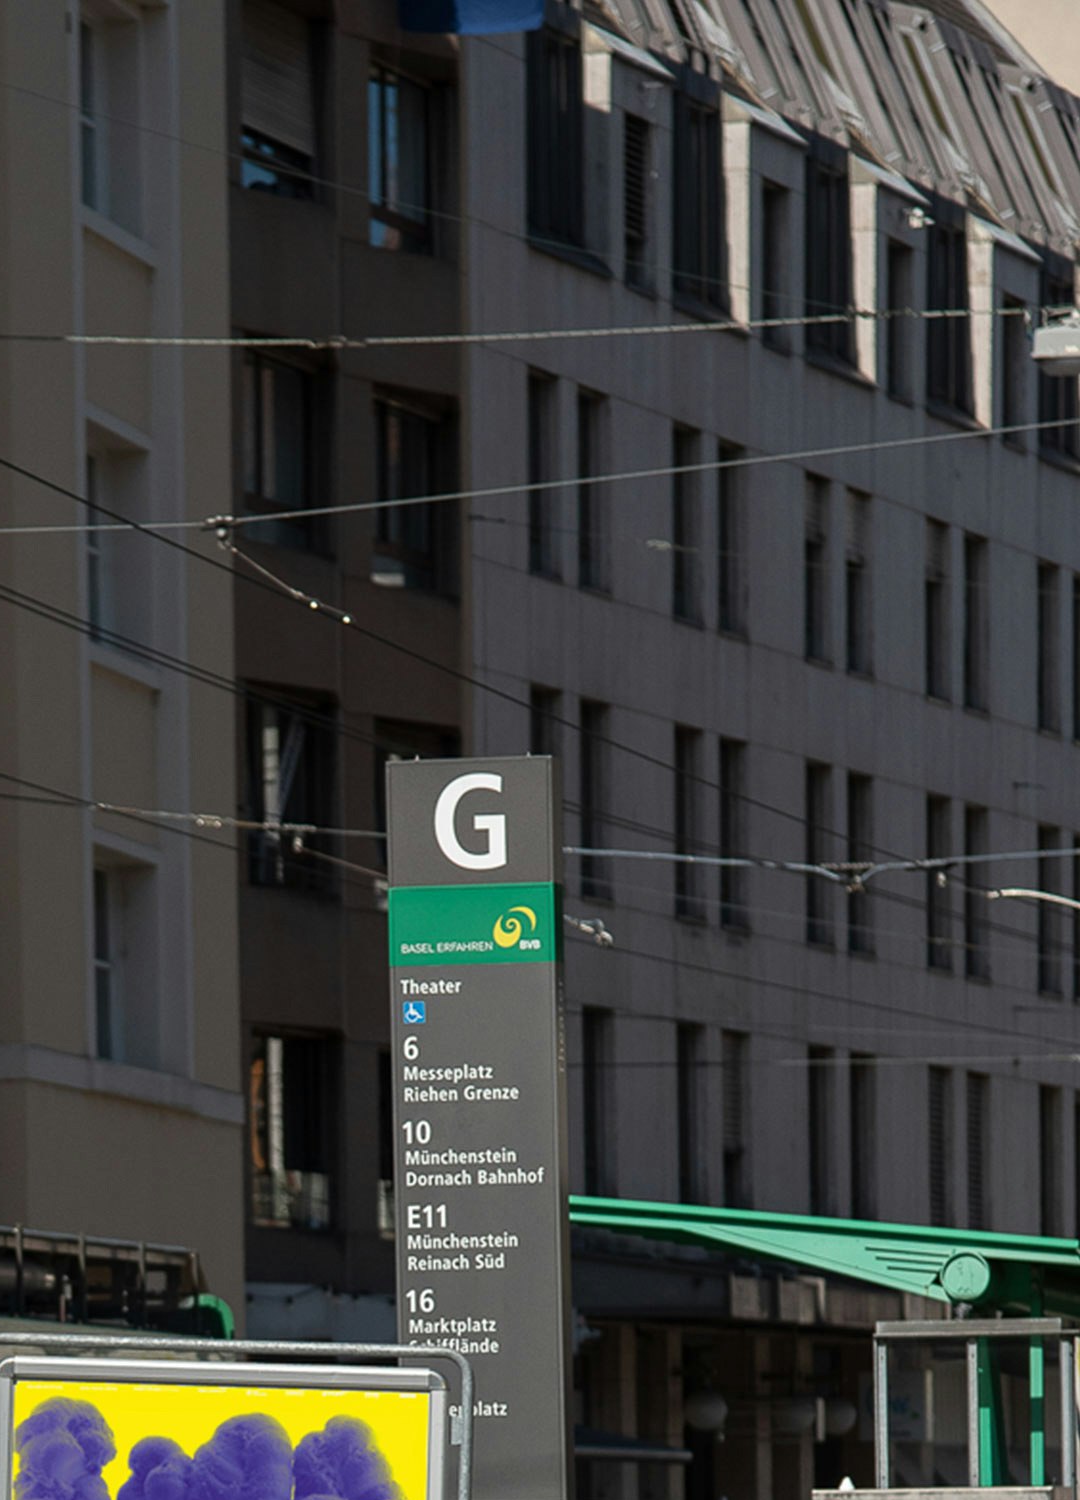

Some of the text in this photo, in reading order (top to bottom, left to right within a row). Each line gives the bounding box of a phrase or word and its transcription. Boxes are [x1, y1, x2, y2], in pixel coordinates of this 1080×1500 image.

[434, 773, 507, 870] G
[400, 939, 541, 955] BASEL ERFAHREN BVB
[400, 979, 462, 995] Theater
[403, 1035, 419, 1060] 6
[403, 1064, 493, 1083] Messeplatz
[404, 1085, 520, 1102] Riehen Grenze
[402, 1120, 431, 1144] 10
[405, 1147, 517, 1165] Münchenstein
[406, 1167, 545, 1187] Dornach Bahnhof
[407, 1204, 447, 1228] E11
[407, 1231, 519, 1250] Münchenstein
[408, 1253, 505, 1271] Reinach Süd
[406, 1289, 435, 1313] 16
[409, 1317, 497, 1336] Marktplatz
[409, 1337, 500, 1353] hifflände
